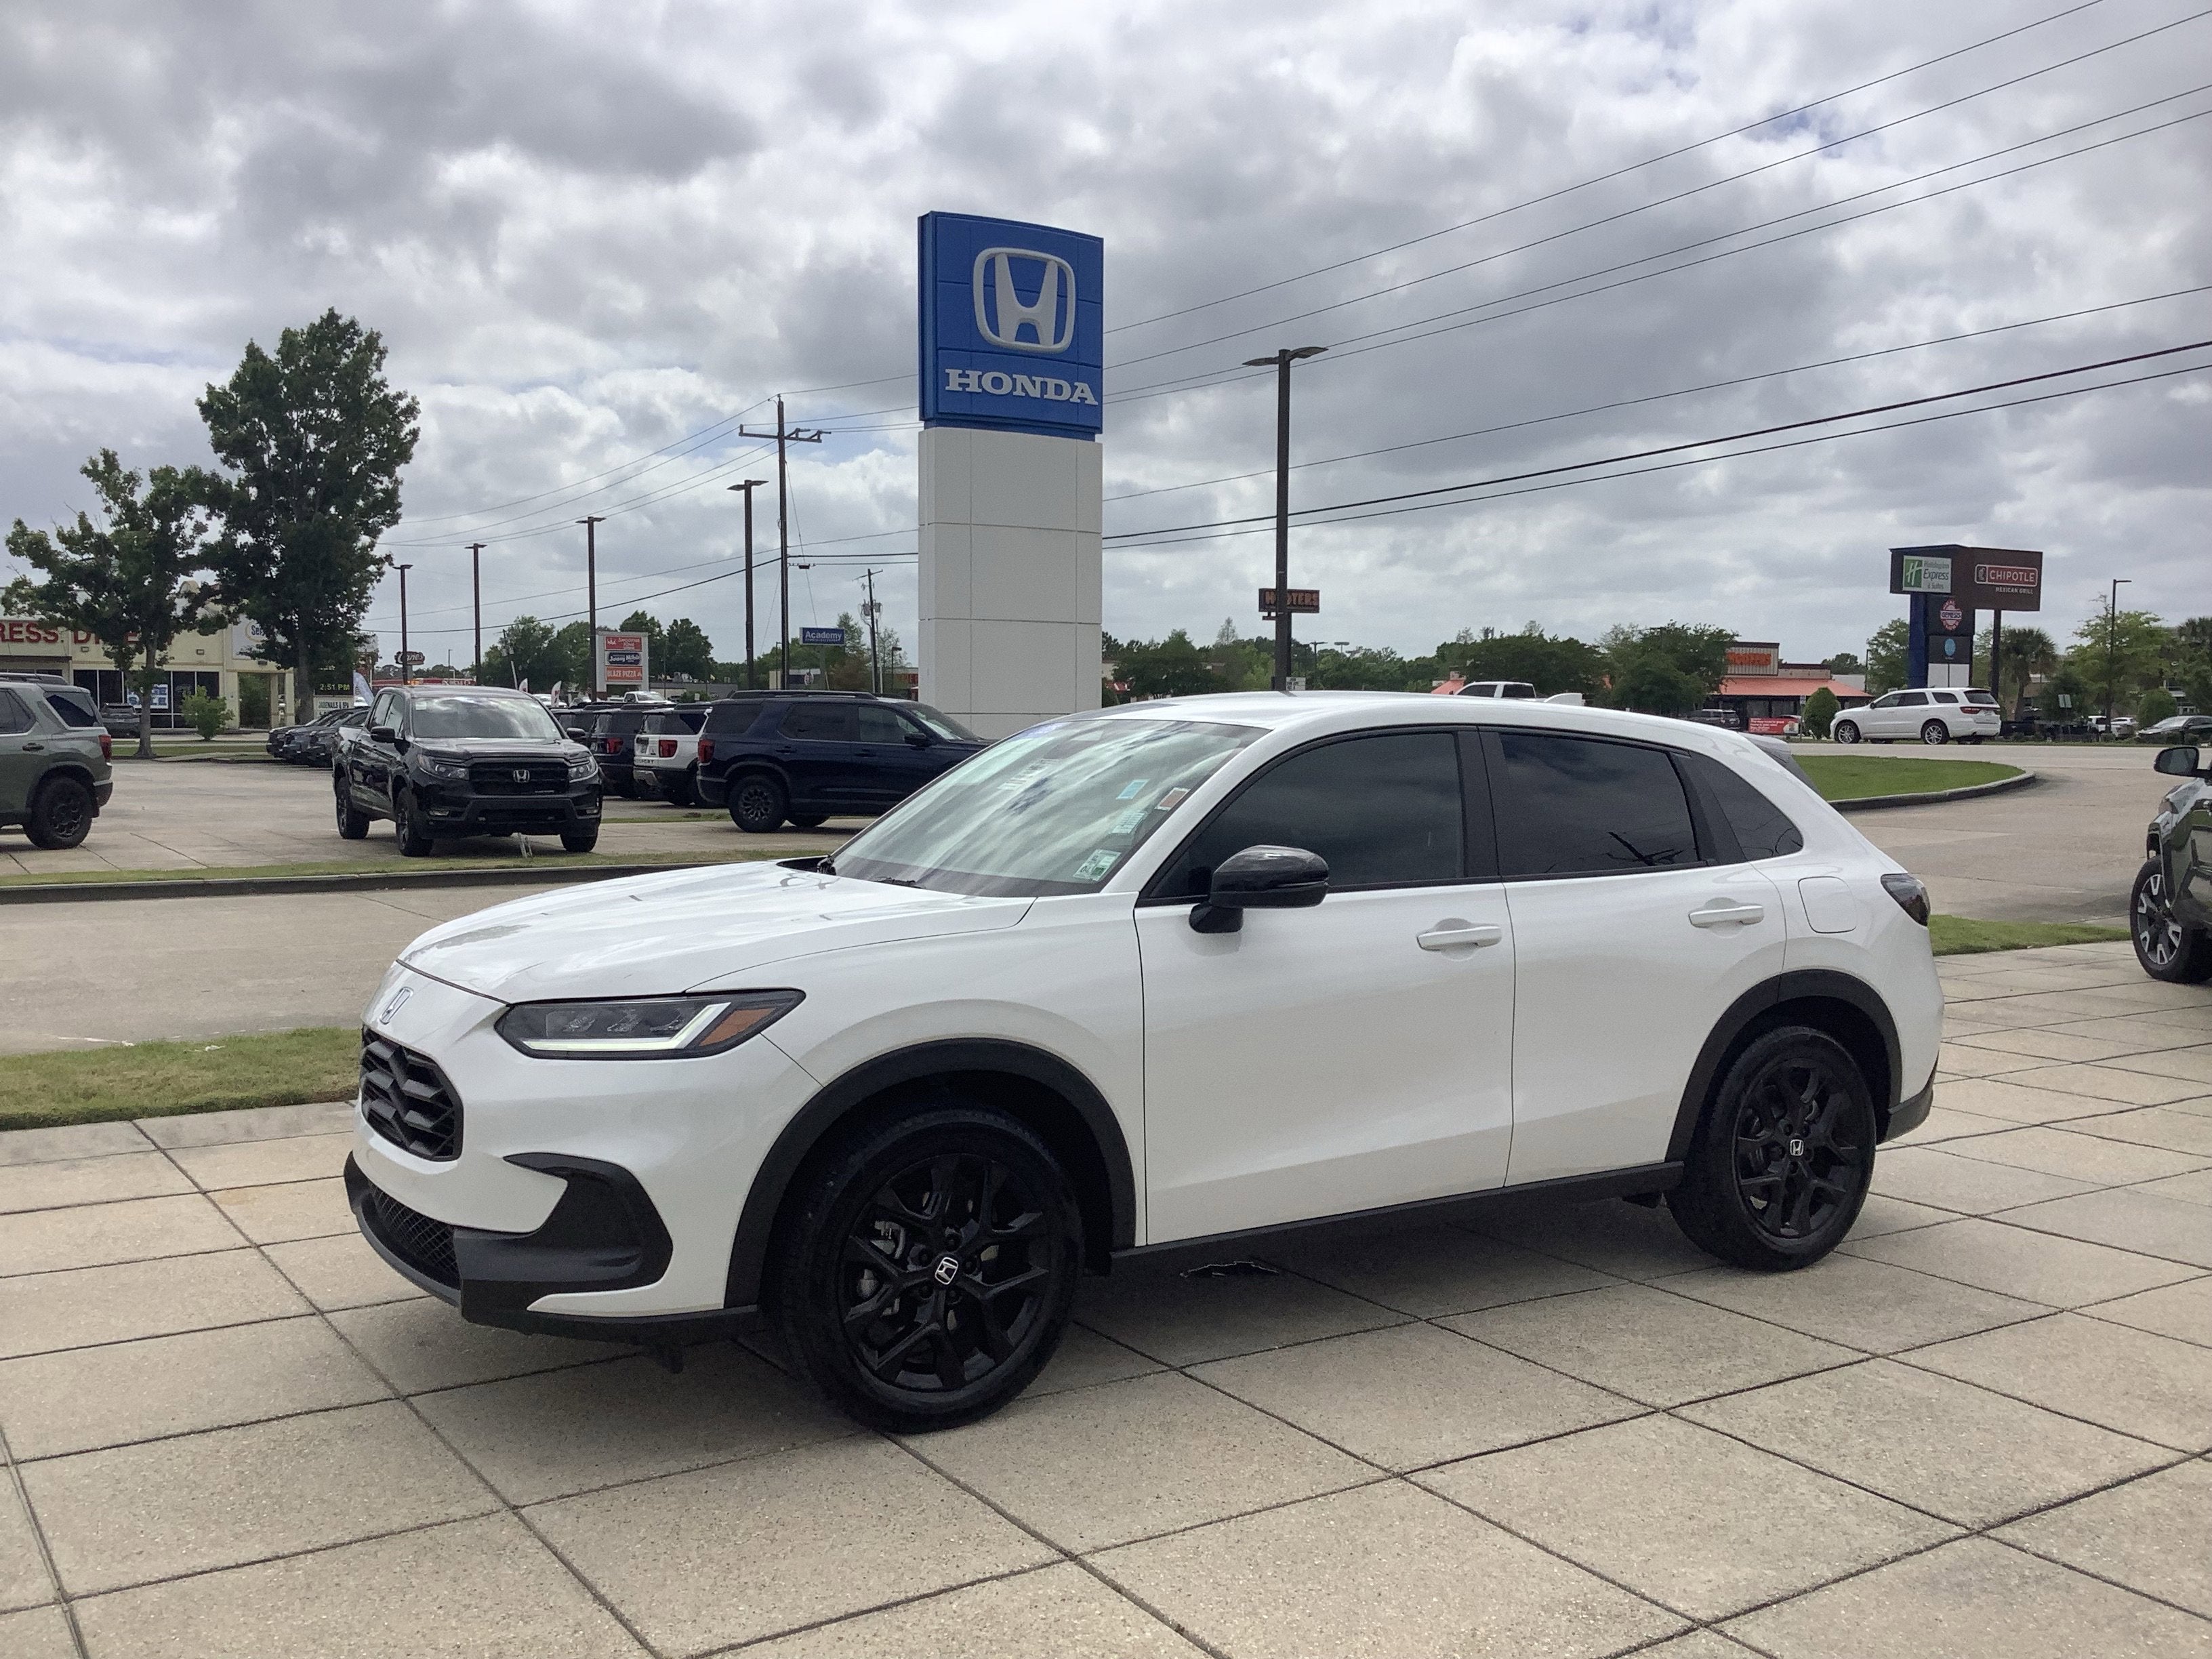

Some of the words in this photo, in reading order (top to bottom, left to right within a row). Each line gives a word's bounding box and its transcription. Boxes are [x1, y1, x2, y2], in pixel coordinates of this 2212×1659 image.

[945, 369, 1099, 406] HONDA
[1923, 569, 1949, 581] Express
[1989, 570, 2035, 582] CHIPOTLE
[1265, 591, 1319, 606] HOTERS
[805, 631, 842, 641] Academy
